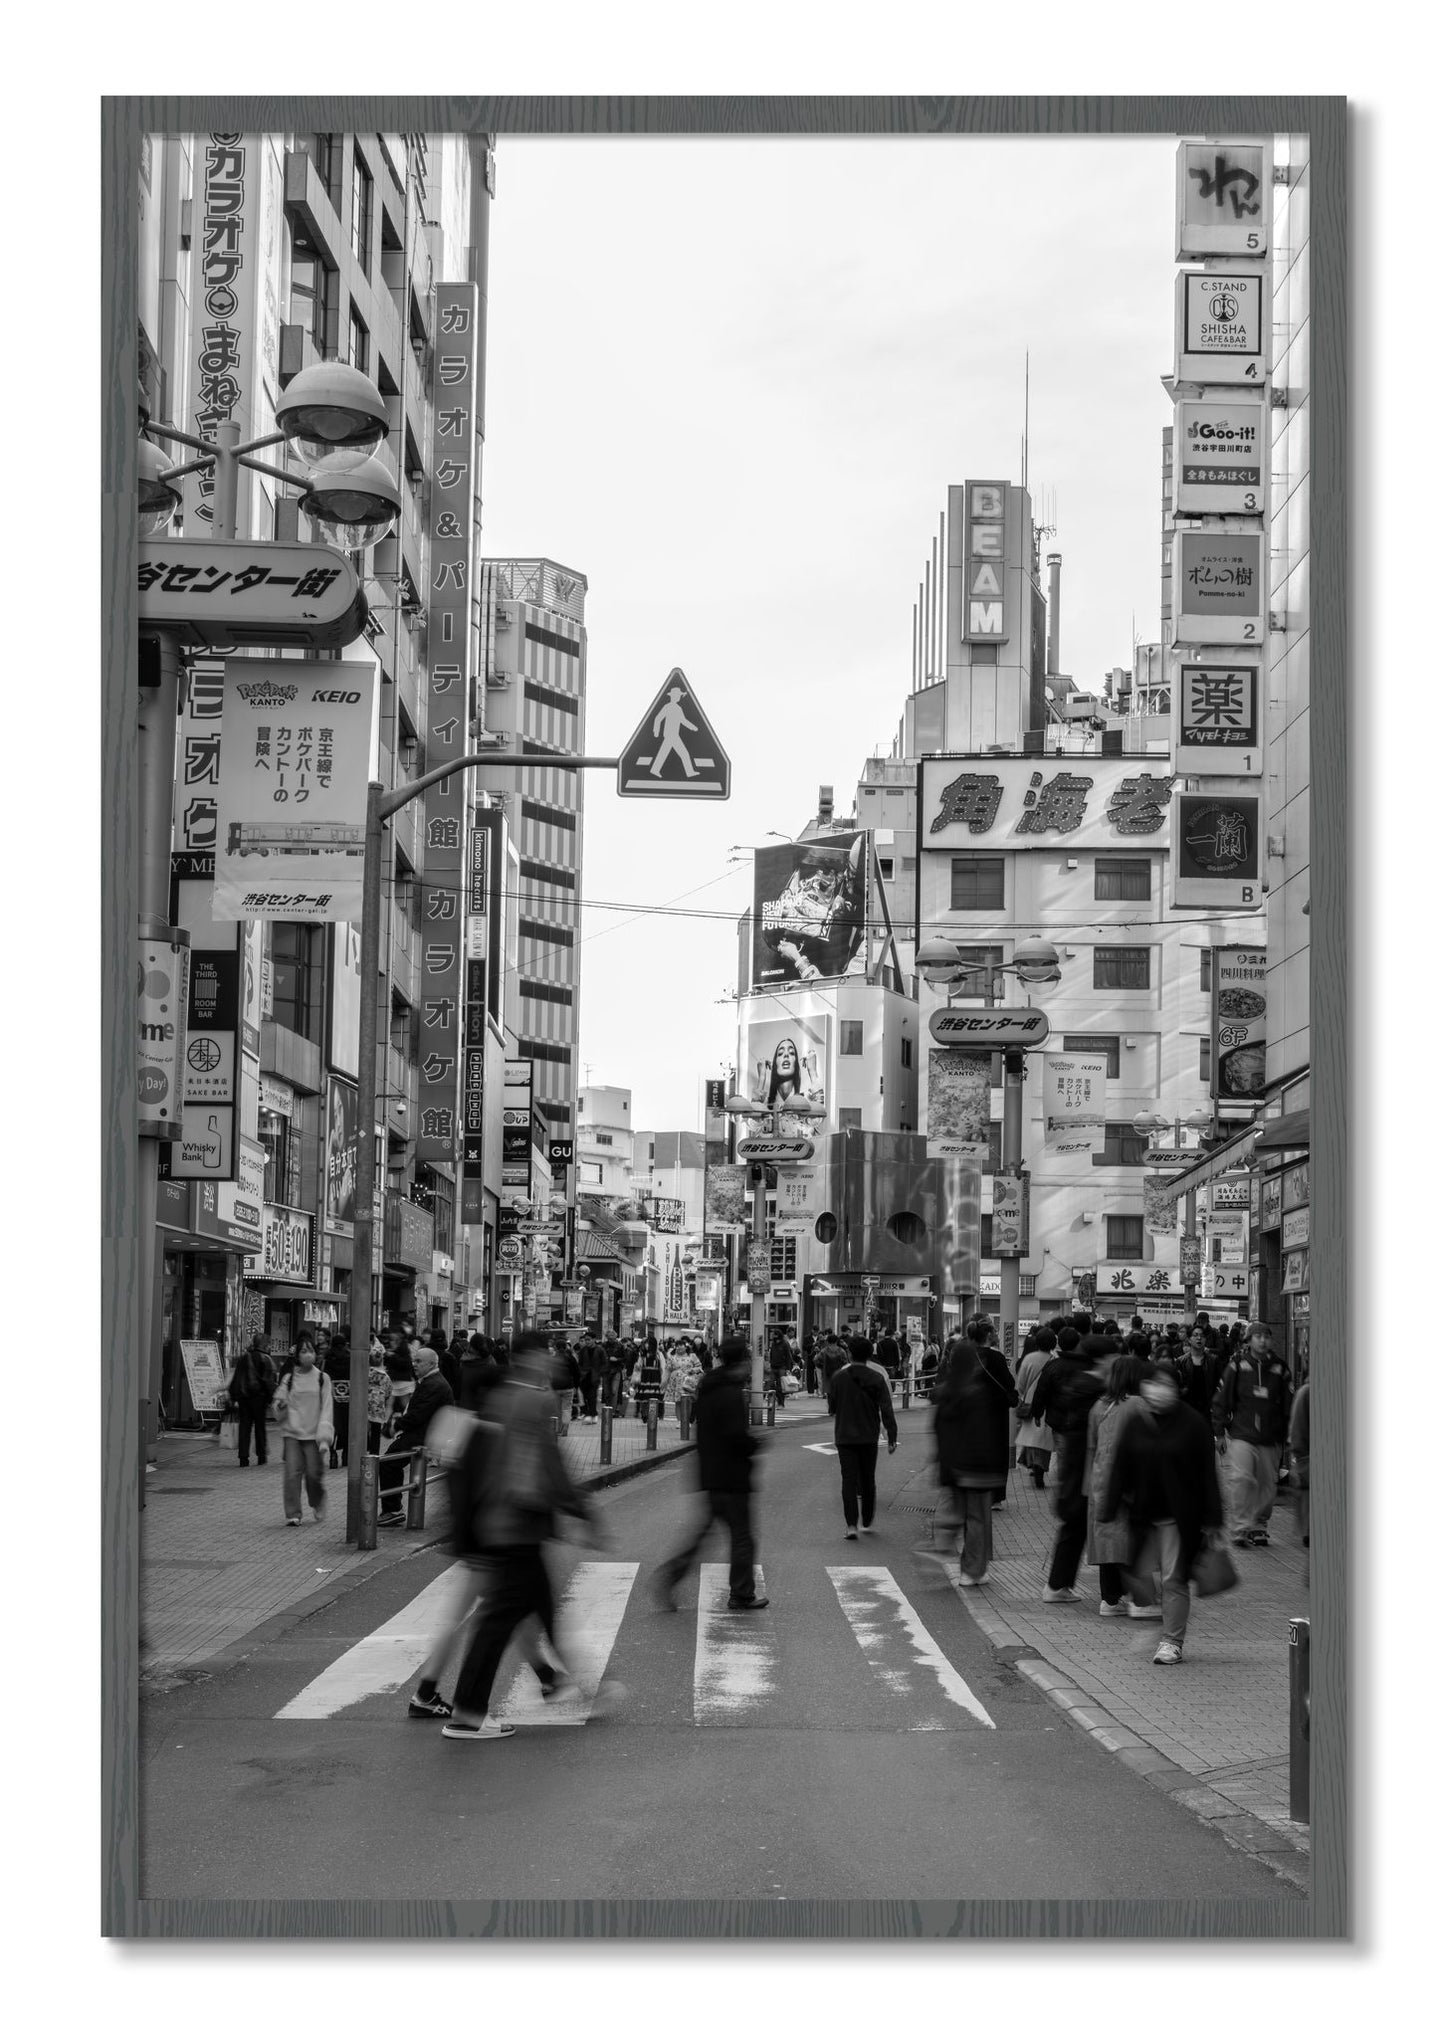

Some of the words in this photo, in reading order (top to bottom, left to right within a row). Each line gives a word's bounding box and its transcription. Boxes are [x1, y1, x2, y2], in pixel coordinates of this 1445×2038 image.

[203, 147, 245, 287] カラオケ
[1246, 234, 1259, 249] 5
[1201, 282, 1247, 292] C.STAND
[1201, 323, 1247, 334] SHISHA
[1201, 335, 1246, 343] CAFE&BAR
[1245, 363, 1257, 378] 4
[1199, 424, 1256, 440] Goo-it!
[1192, 444, 1252, 453] 渋谷宇田川町店
[1187, 470, 1257, 481] 全身もみほぐし
[1244, 493, 1257, 509] 3
[969, 485, 1004, 634] BEAM
[1243, 623, 1256, 639] 2
[250, 698, 286, 706] KANTO
[311, 690, 361, 704] KEIO
[1191, 673, 1243, 725] 薬
[1185, 728, 1249, 743] マツモトキヨシ
[254, 727, 271, 770] 冒険へ
[274, 727, 292, 803] カントーの
[316, 728, 334, 789] 京王線で
[1243, 755, 1251, 771] 1
[930, 771, 1174, 834] 角海老
[1186, 812, 1248, 861] 一蘭
[473, 833, 483, 869] kimono
[473, 875, 483, 909] hearts
[1241, 886, 1254, 902] B
[242, 893, 333, 907] 渋谷センター街
[195, 970, 218, 978] THIRD
[199, 963, 215, 971] THE
[198, 1010, 213, 1018] BAR
[421, 891, 458, 1139] カラオケ館
[936, 1018, 1042, 1031] 渋谷センター街
[183, 1143, 217, 1154] Whisky
[551, 1146, 572, 1158] GU
[741, 1143, 805, 1153] 渋谷センター街
[182, 1152, 203, 1161] Bank
[1111, 1268, 1171, 1291] 兆楽
[673, 1267, 682, 1310] BEER
